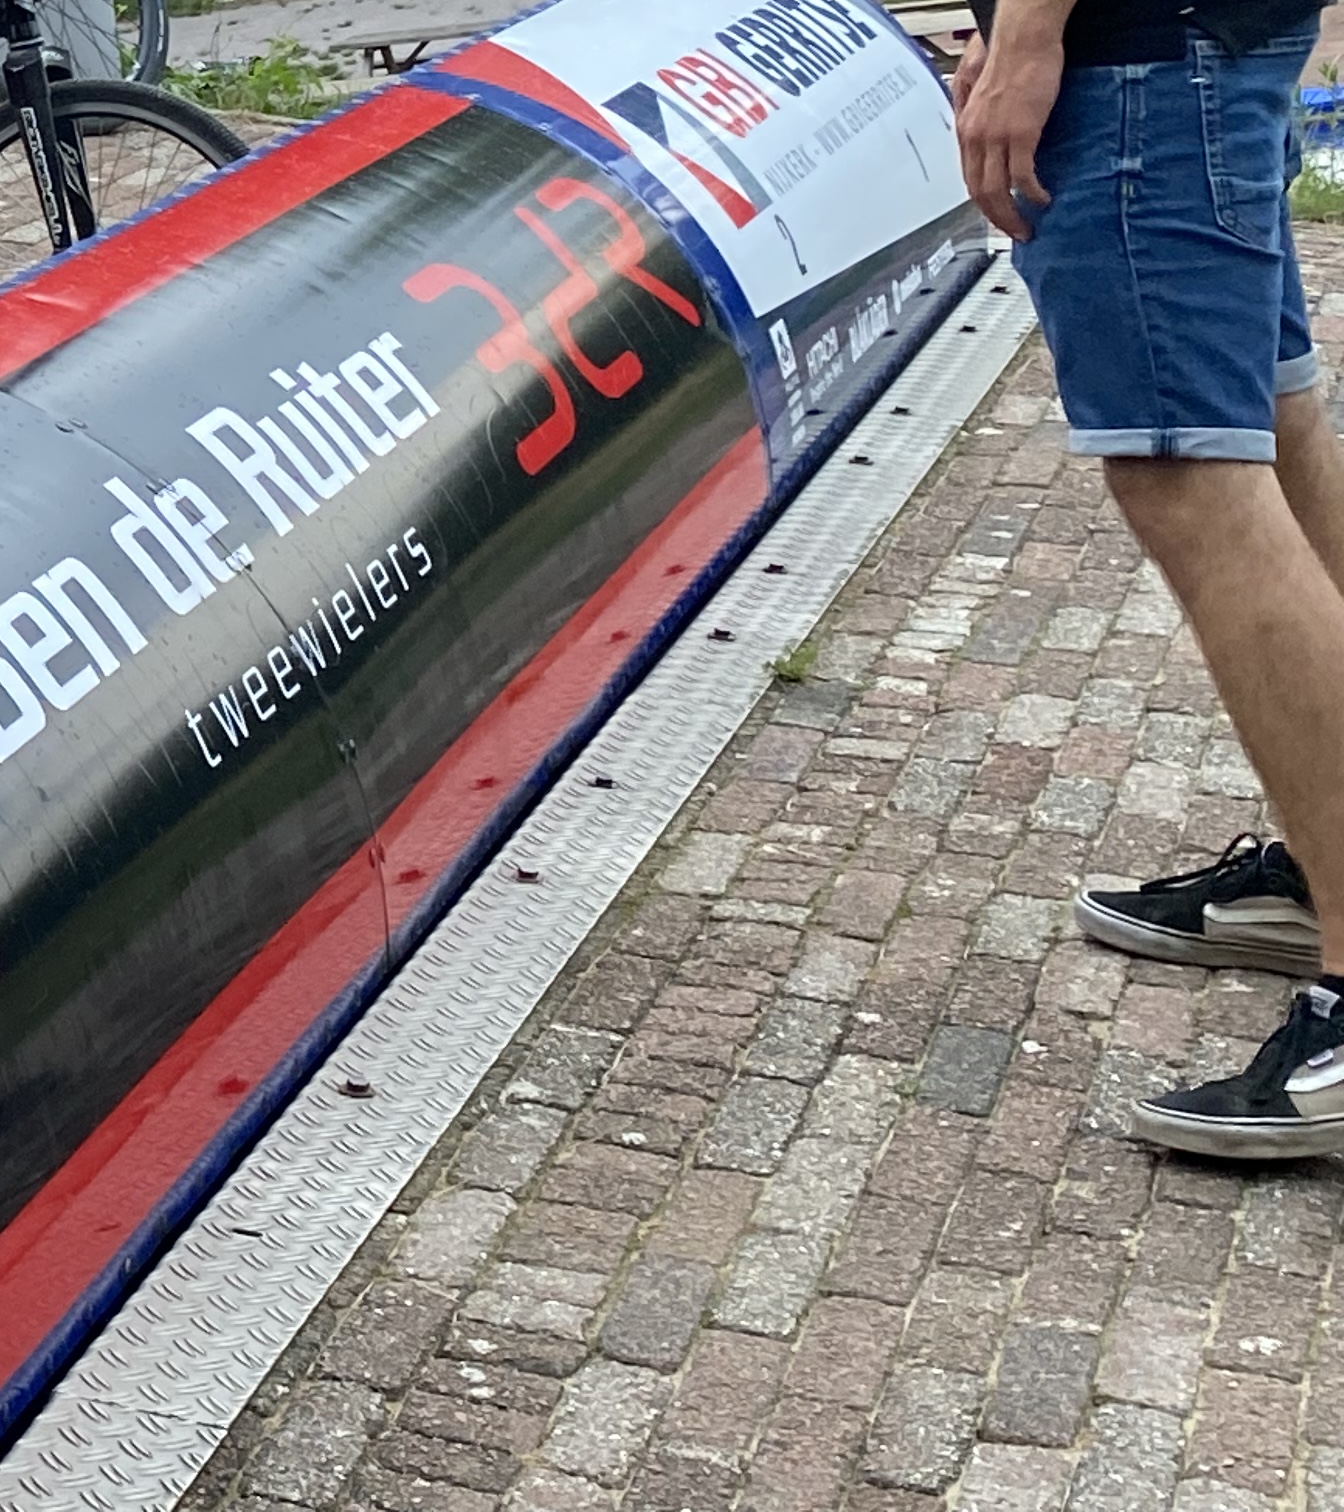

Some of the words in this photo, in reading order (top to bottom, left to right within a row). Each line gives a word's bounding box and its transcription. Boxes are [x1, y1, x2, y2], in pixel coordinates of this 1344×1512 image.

[656, 47, 781, 138] GBI
[103, 476, 255, 616] de
[184, 331, 441, 537] Ruiter
[184, 526, 433, 768] tweewielers
